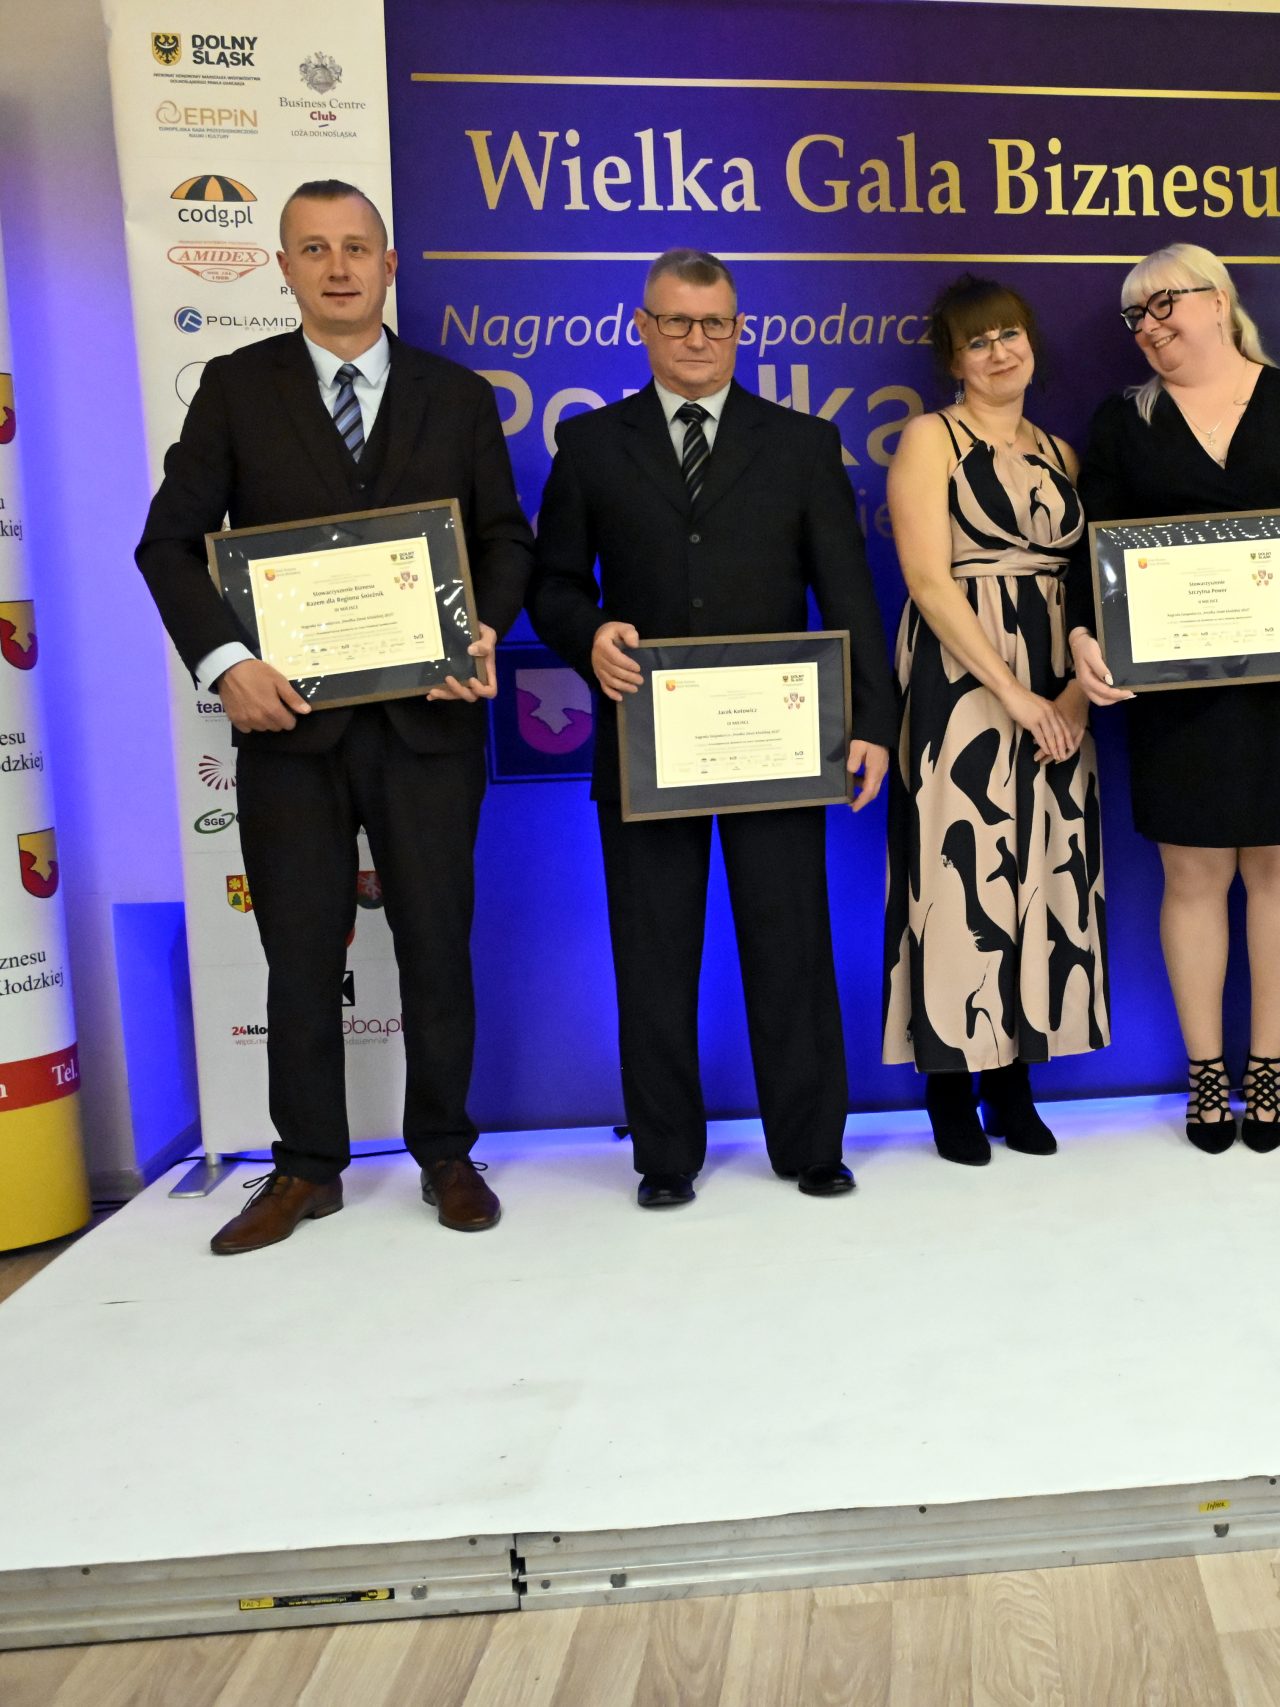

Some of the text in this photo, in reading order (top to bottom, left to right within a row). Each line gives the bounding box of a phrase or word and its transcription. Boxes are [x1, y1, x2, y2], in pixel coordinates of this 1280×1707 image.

[192, 34, 258, 50] DOLNY
[192, 48, 254, 68] ŚLĄSK
[279, 97, 366, 110] Business Centre
[310, 111, 337, 122] Club
[465, 128, 760, 212] Wielka
[785, 133, 966, 215] Gala
[178, 205, 253, 228] codg.pl
[178, 249, 258, 263] AMIDEX
[737, 303, 934, 358] spodarcz
[0, 519, 23, 541] kiej
[196, 700, 226, 714] tea
[0, 750, 44, 773] dzkiej
[203, 818, 226, 827] SGB
[231, 1024, 268, 1036] 24klo
[51, 1058, 78, 1087] Tel.
